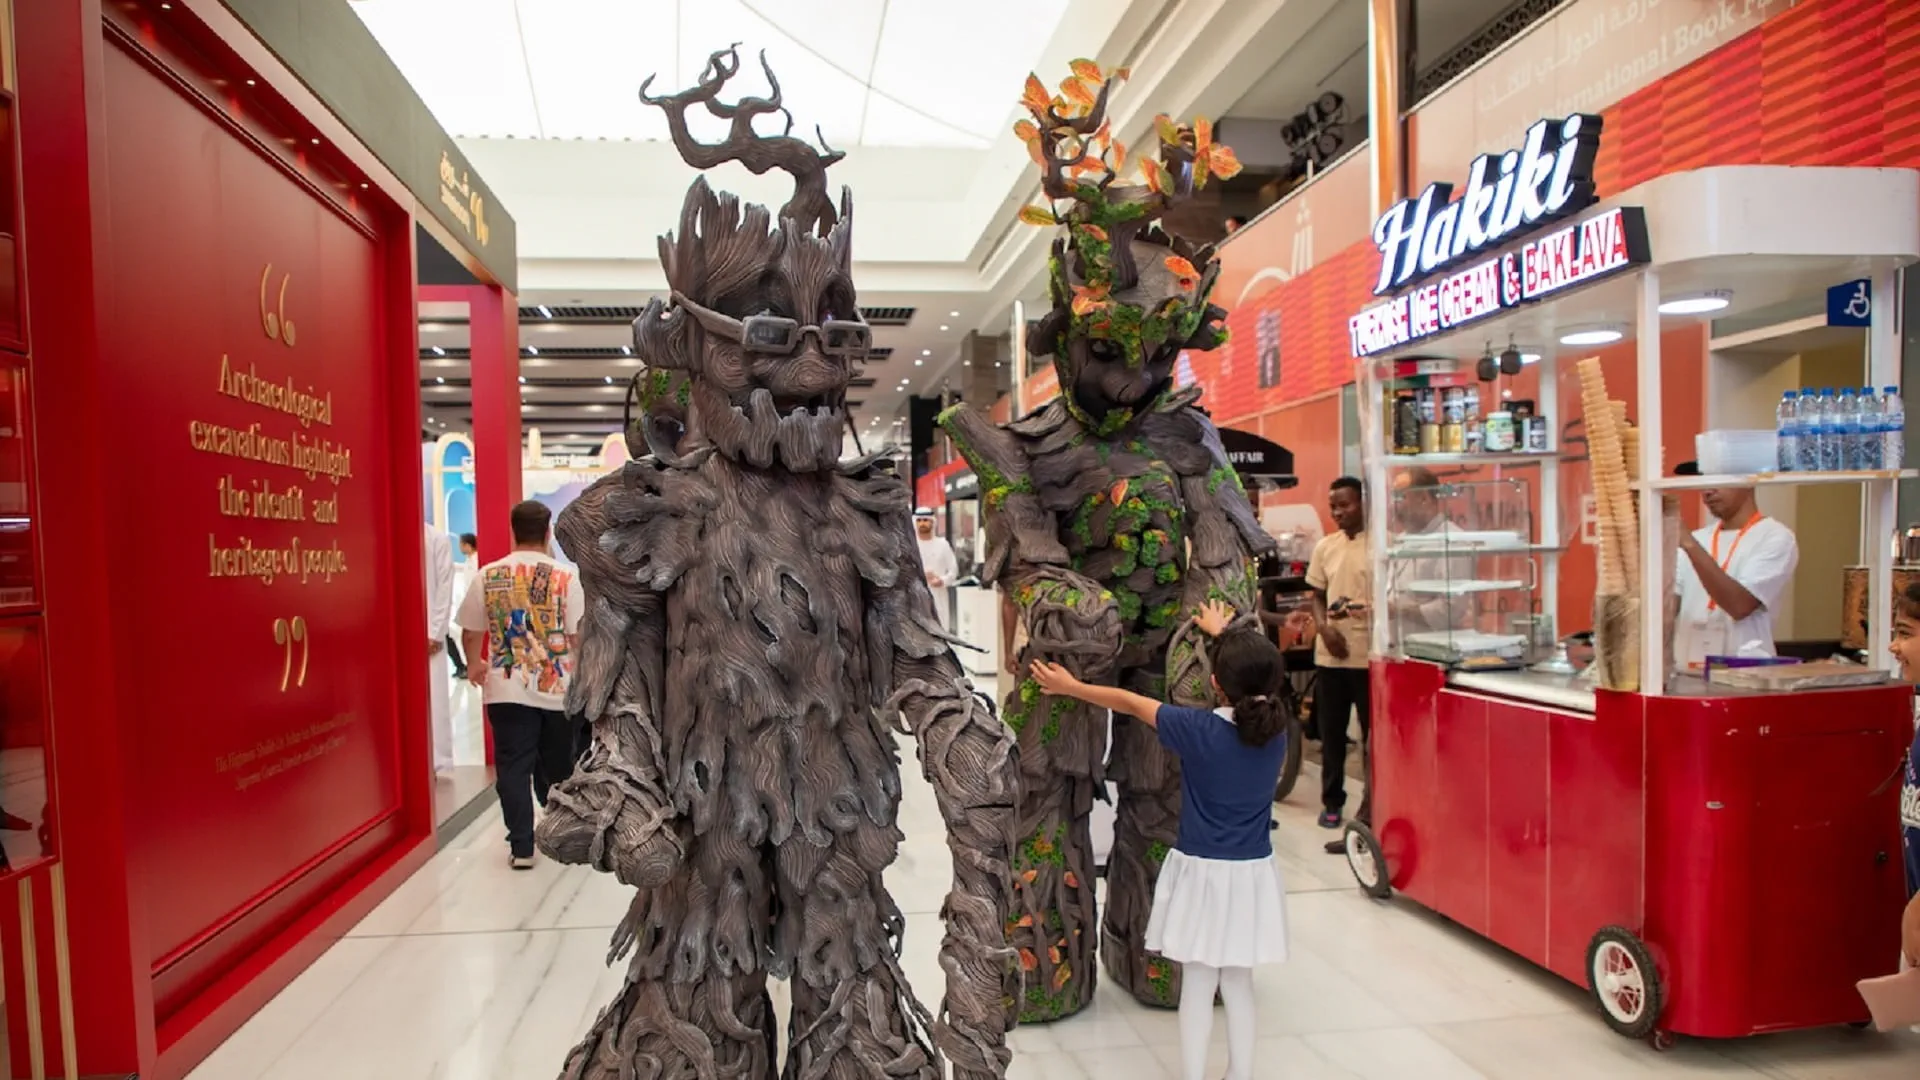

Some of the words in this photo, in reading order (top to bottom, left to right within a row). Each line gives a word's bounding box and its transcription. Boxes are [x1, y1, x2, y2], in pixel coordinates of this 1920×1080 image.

[1673, 1, 1736, 56] Book
[1373, 115, 1582, 295] Hakiki
[1409, 285, 1439, 337] ICE
[1439, 258, 1500, 327] CREAM
[1502, 252, 1521, 305] &
[1523, 207, 1629, 298] BAKLAVA
[217, 353, 332, 428] Archaeological
[190, 420, 289, 466] excavations
[292, 431, 352, 485] highlight
[217, 474, 250, 517] the
[312, 491, 338, 524] and
[209, 533, 281, 585] heritage
[283, 536, 300, 575] of
[302, 539, 348, 585] people.
